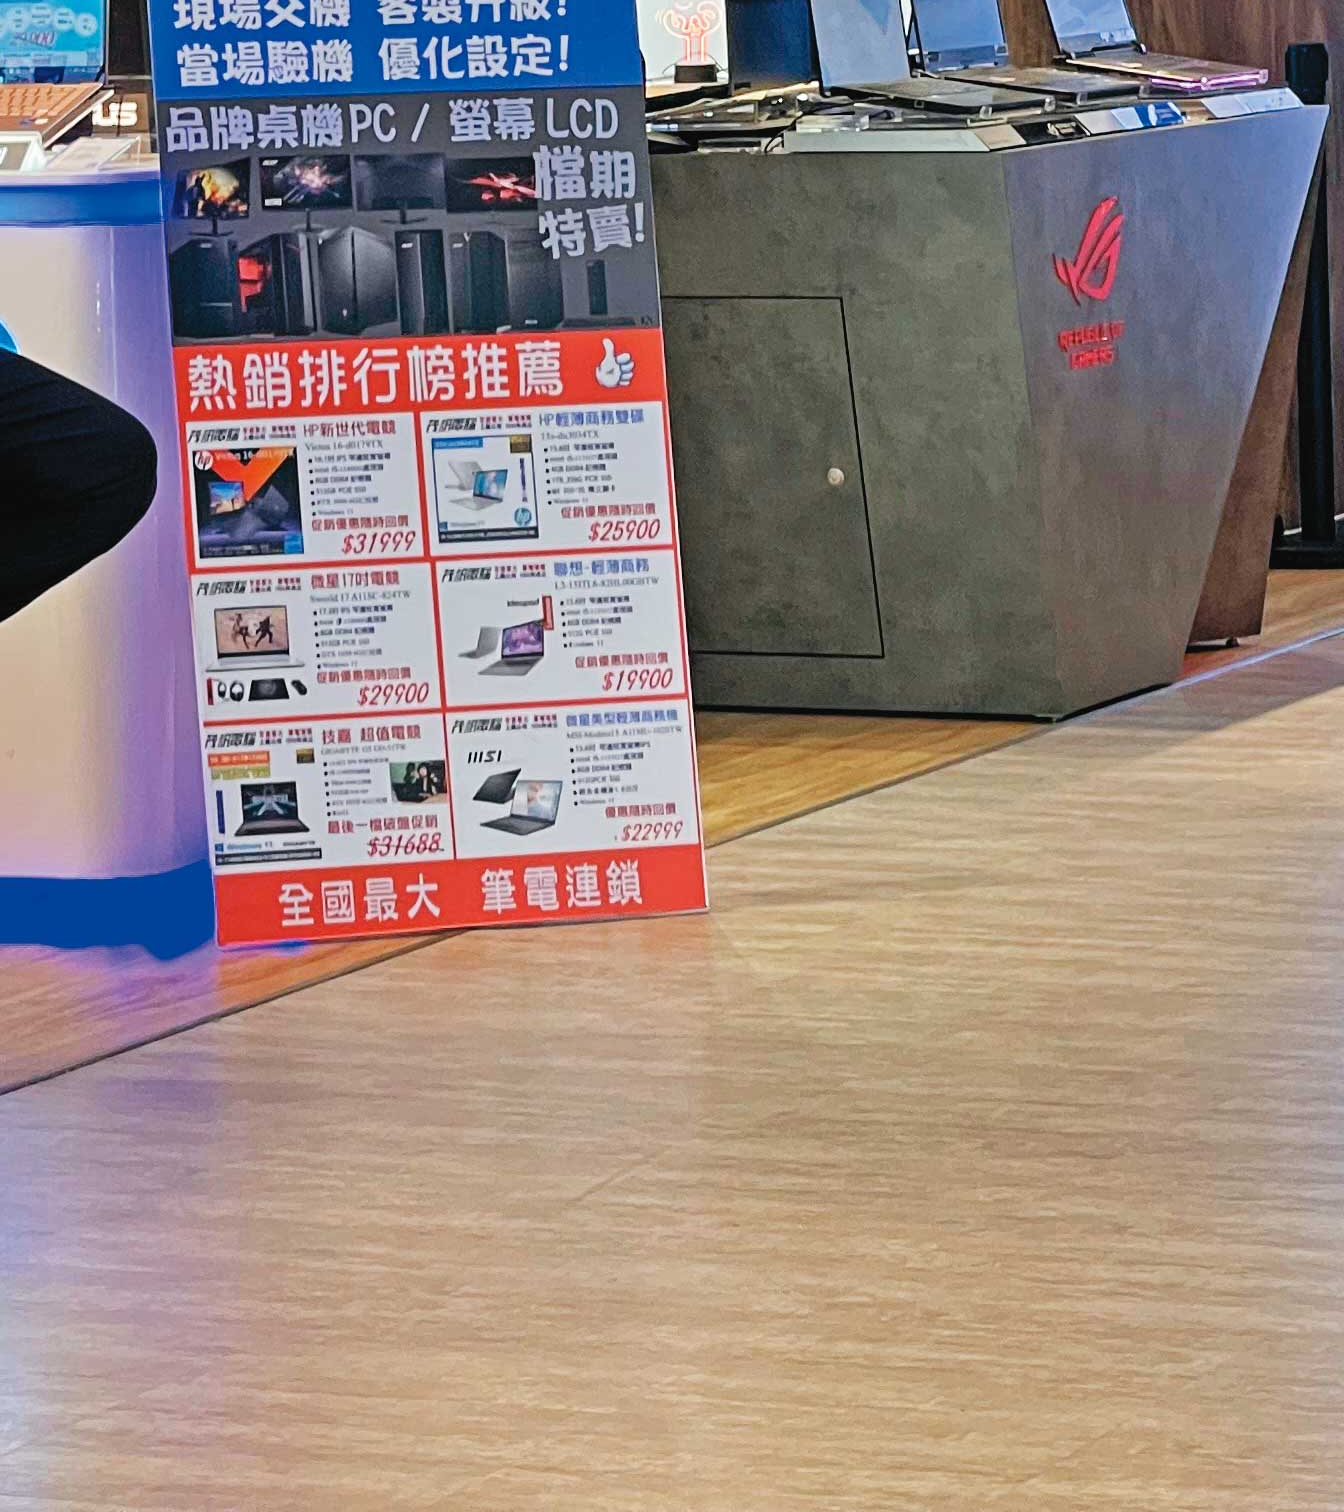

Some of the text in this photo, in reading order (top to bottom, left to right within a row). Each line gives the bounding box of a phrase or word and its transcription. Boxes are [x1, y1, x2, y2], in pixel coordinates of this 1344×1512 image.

[176, 34, 569, 88] 當場驗機 優化設定!
[532, 144, 636, 202] 檔期
[538, 201, 646, 260] 特賣!
[187, 339, 564, 412] 熱銷排行榜推薦
[341, 530, 416, 555] $31999
[588, 518, 661, 542] $25900
[602, 667, 674, 692] $19900
[357, 681, 430, 707] $29900
[621, 819, 684, 843] $22999
[366, 832, 443, 858] $31688
[277, 859, 644, 930] 全國最大 筆電連鎖
